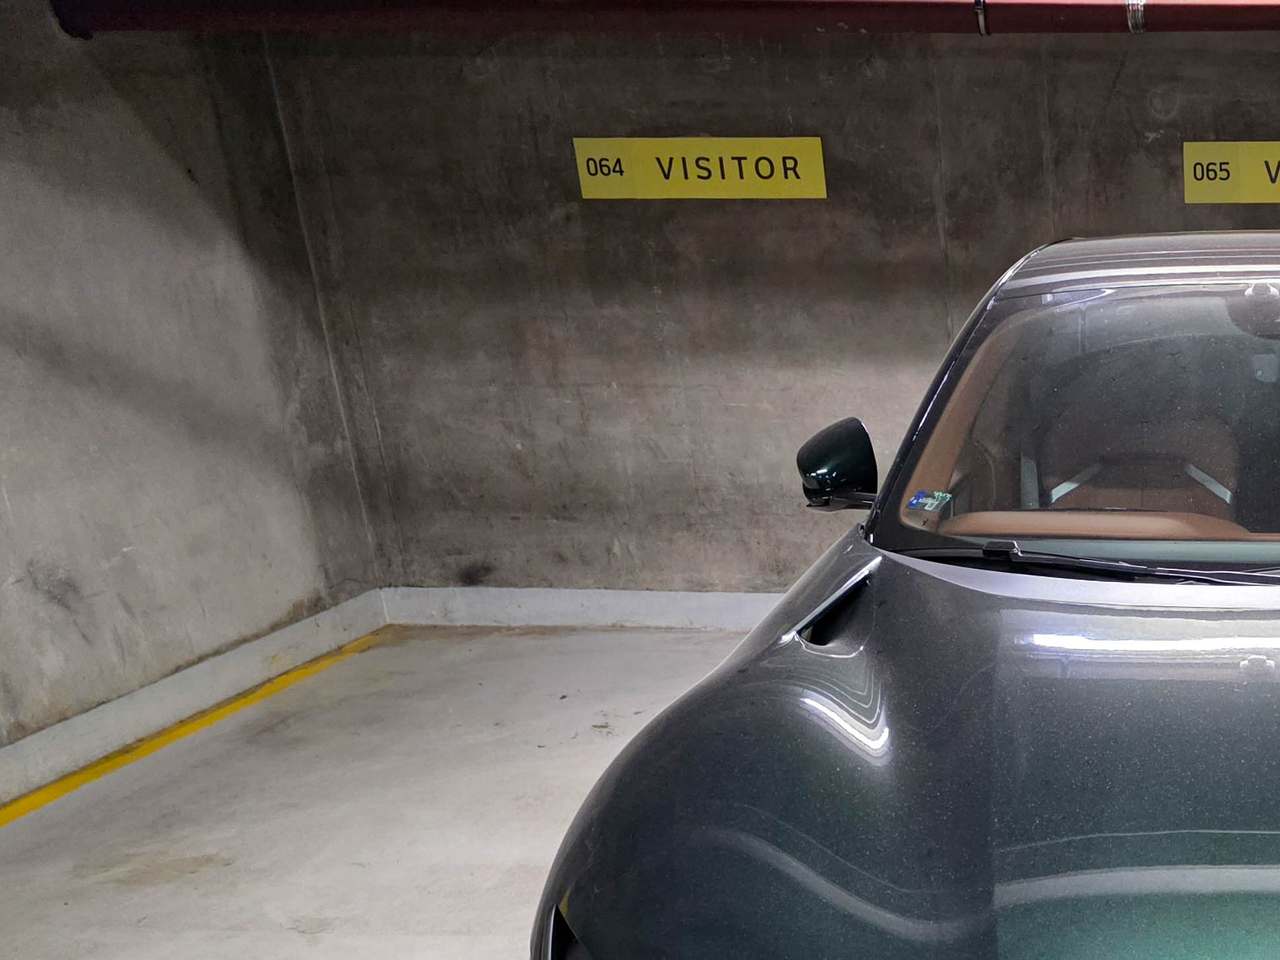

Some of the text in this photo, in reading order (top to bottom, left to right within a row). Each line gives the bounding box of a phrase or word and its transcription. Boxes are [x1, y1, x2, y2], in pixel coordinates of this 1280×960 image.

[586, 156, 802, 181] 064 VISITOR
[1192, 161, 1231, 182] 065
